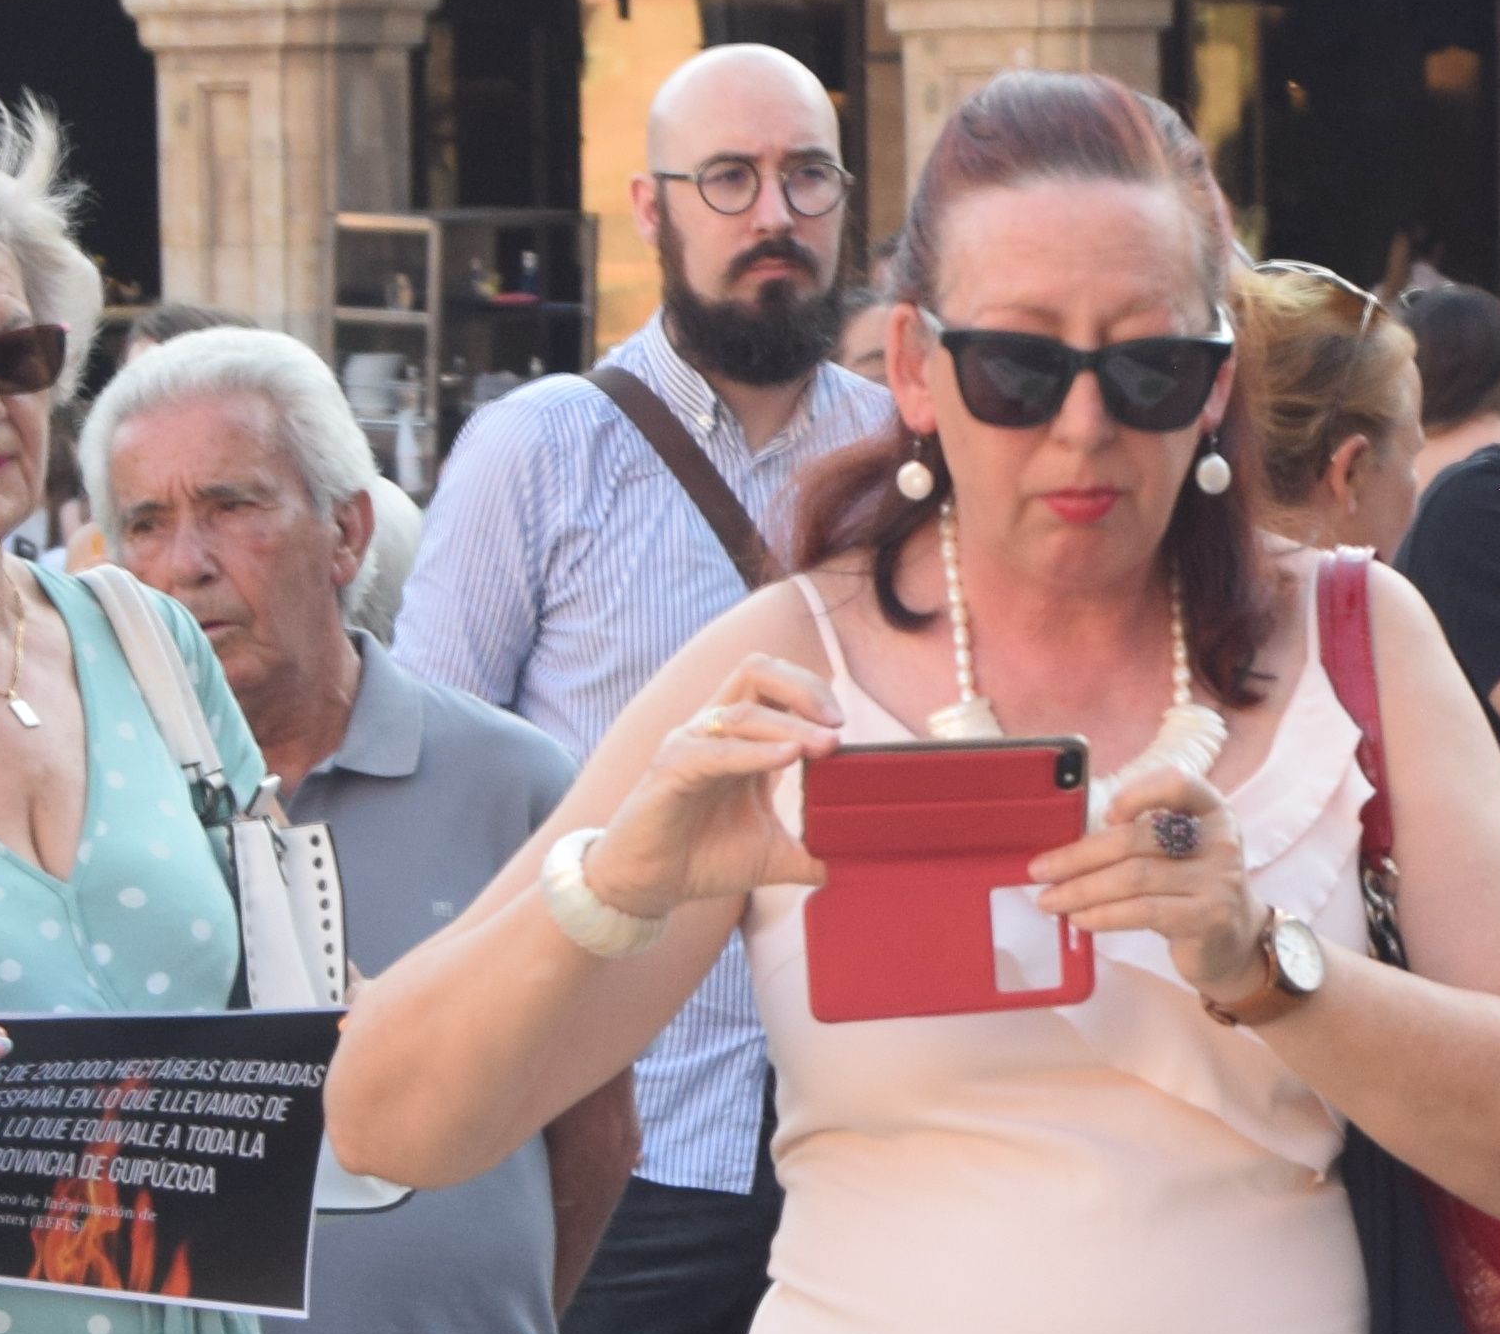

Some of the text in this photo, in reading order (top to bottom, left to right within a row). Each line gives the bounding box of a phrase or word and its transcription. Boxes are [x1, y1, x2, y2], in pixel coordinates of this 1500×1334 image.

[5, 1064, 33, 1083] DE
[32, 1060, 112, 1082] 200.000
[109, 1056, 217, 1083] HECTÁREAS
[219, 1060, 326, 1088] QUEMADAS
[65, 1088, 94, 1109] EN
[92, 1088, 121, 1110] LO
[121, 1089, 159, 1112] QUE
[159, 1090, 265, 1121] LLEVAMOS
[263, 1097, 293, 1123] DE
[2, 1116, 32, 1138] LO
[30, 1117, 72, 1140] QUE
[69, 1117, 166, 1148] EQUIVALE
[164, 1126, 184, 1149] A
[186, 1126, 236, 1156] TODA
[238, 1131, 268, 1160] LA
[76, 1153, 107, 1180] DE
[108, 1156, 218, 1195] GUIPÚZCOA
[21, 1194, 40, 1207] de
[138, 1206, 158, 1222] de
